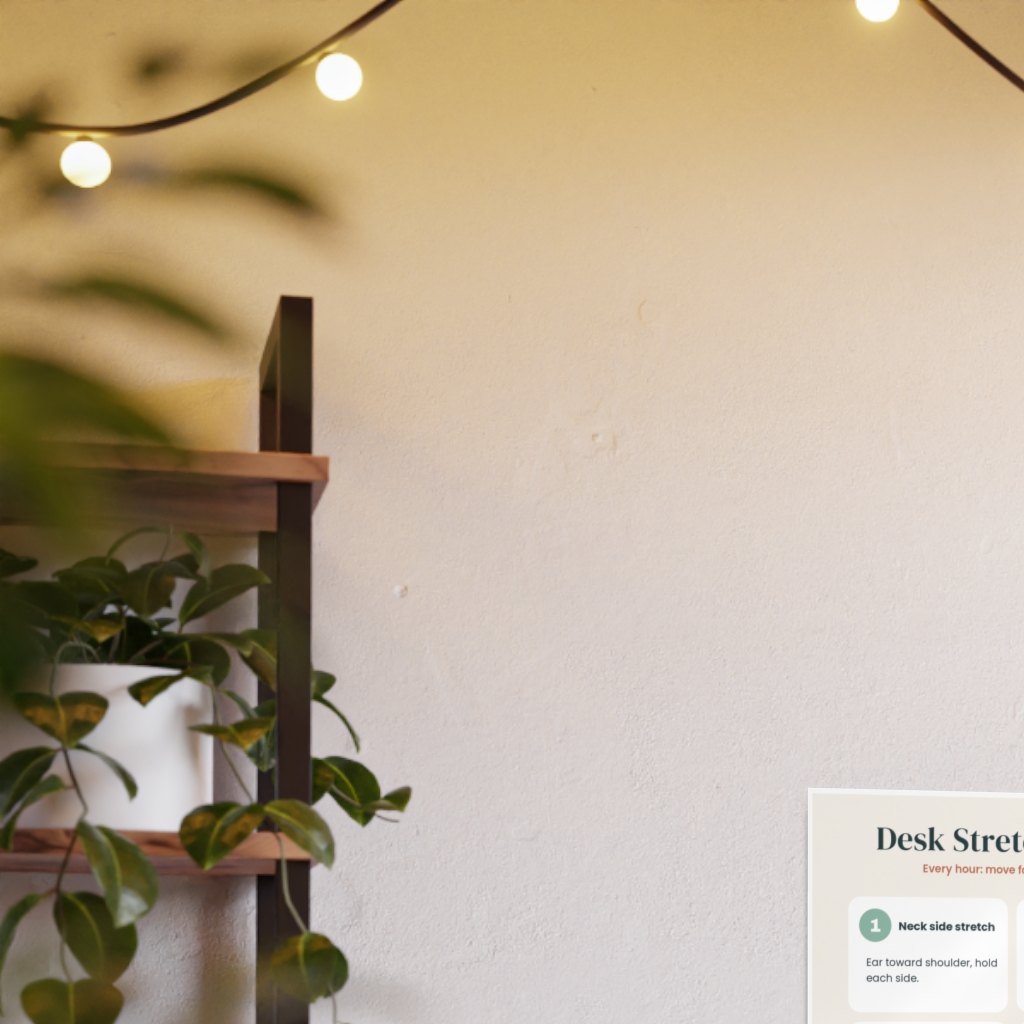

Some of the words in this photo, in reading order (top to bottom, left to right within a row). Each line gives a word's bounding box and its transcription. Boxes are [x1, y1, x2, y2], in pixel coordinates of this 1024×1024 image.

[877, 826, 945, 852] Desk
[922, 863, 953, 877] Every
[955, 863, 983, 874] hour:
[985, 866, 1016, 875] move
[870, 918, 881, 933] 1
[898, 921, 928, 931] Neck
[929, 920, 953, 932] side
[954, 922, 996, 932] stretch
[866, 957, 884, 967] Ear
[885, 957, 923, 967] toward
[925, 957, 973, 969] shoulder,
[975, 958, 998, 968] hold
[865, 973, 893, 983] each
[895, 973, 919, 983] side.
